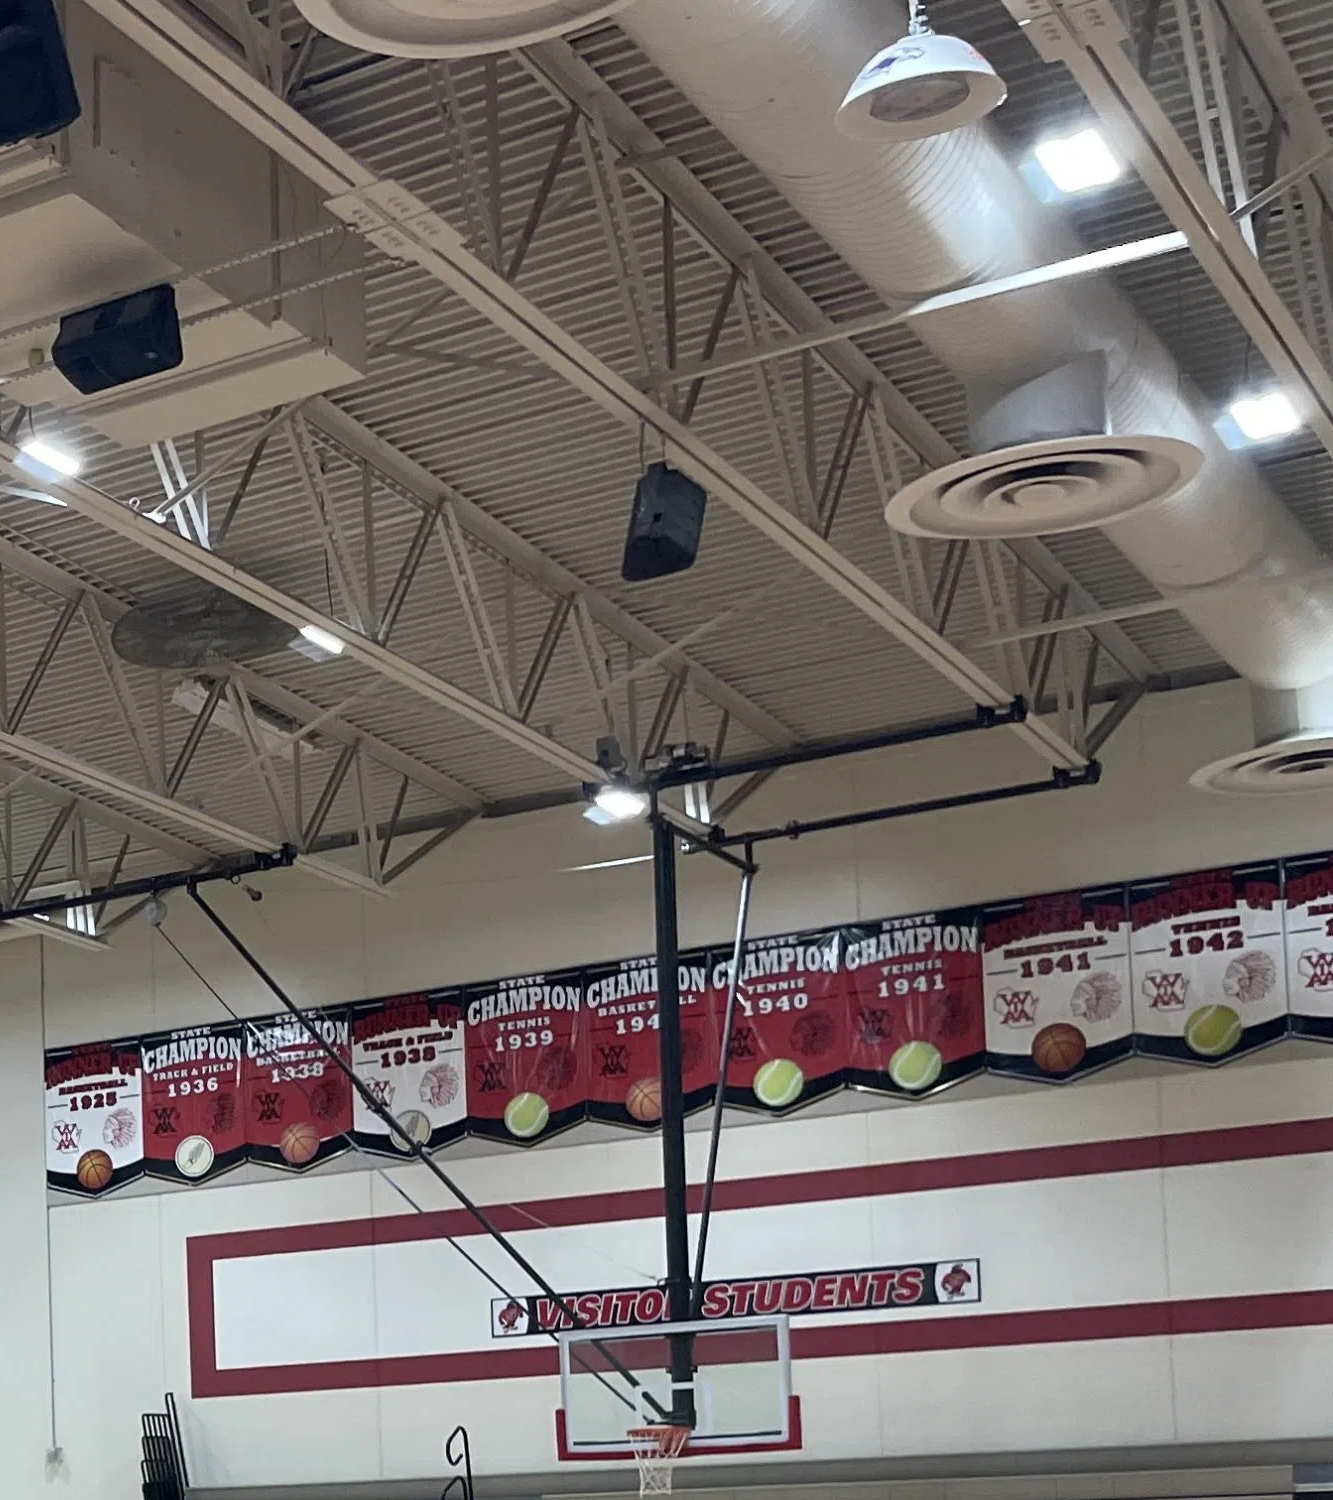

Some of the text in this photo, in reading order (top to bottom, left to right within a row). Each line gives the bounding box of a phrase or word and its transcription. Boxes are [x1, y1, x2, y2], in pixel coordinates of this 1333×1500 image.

[882, 914, 935, 931] STATE
[747, 935, 798, 950] STATE
[845, 925, 978, 970] CHAMPION
[1170, 930, 1244, 957] 1942
[620, 957, 657, 970] STAT
[880, 958, 942, 976] TENNIS
[1020, 952, 1091, 978] 1941
[499, 975, 545, 990] STATE
[587, 965, 706, 1008] CHAMON
[747, 977, 805, 995] TENNIS
[878, 974, 944, 997] 1941
[468, 985, 580, 1026] CHAMPION
[598, 995, 697, 1017] BASKETLL
[743, 993, 808, 1016] 1940
[171, 1026, 211, 1040] STATE
[498, 1016, 550, 1031] TENNIS
[616, 1013, 660, 1035] 194
[495, 1030, 553, 1052] 1939
[143, 1036, 241, 1074] CHAMPION
[153, 1069, 188, 1081] TRACK
[201, 1062, 234, 1075] FIELD
[272, 1062, 324, 1083] 1938
[168, 1077, 218, 1097] 1936
[70, 1091, 117, 1111] 1925
[702, 1268, 925, 1319] STUDENTS
